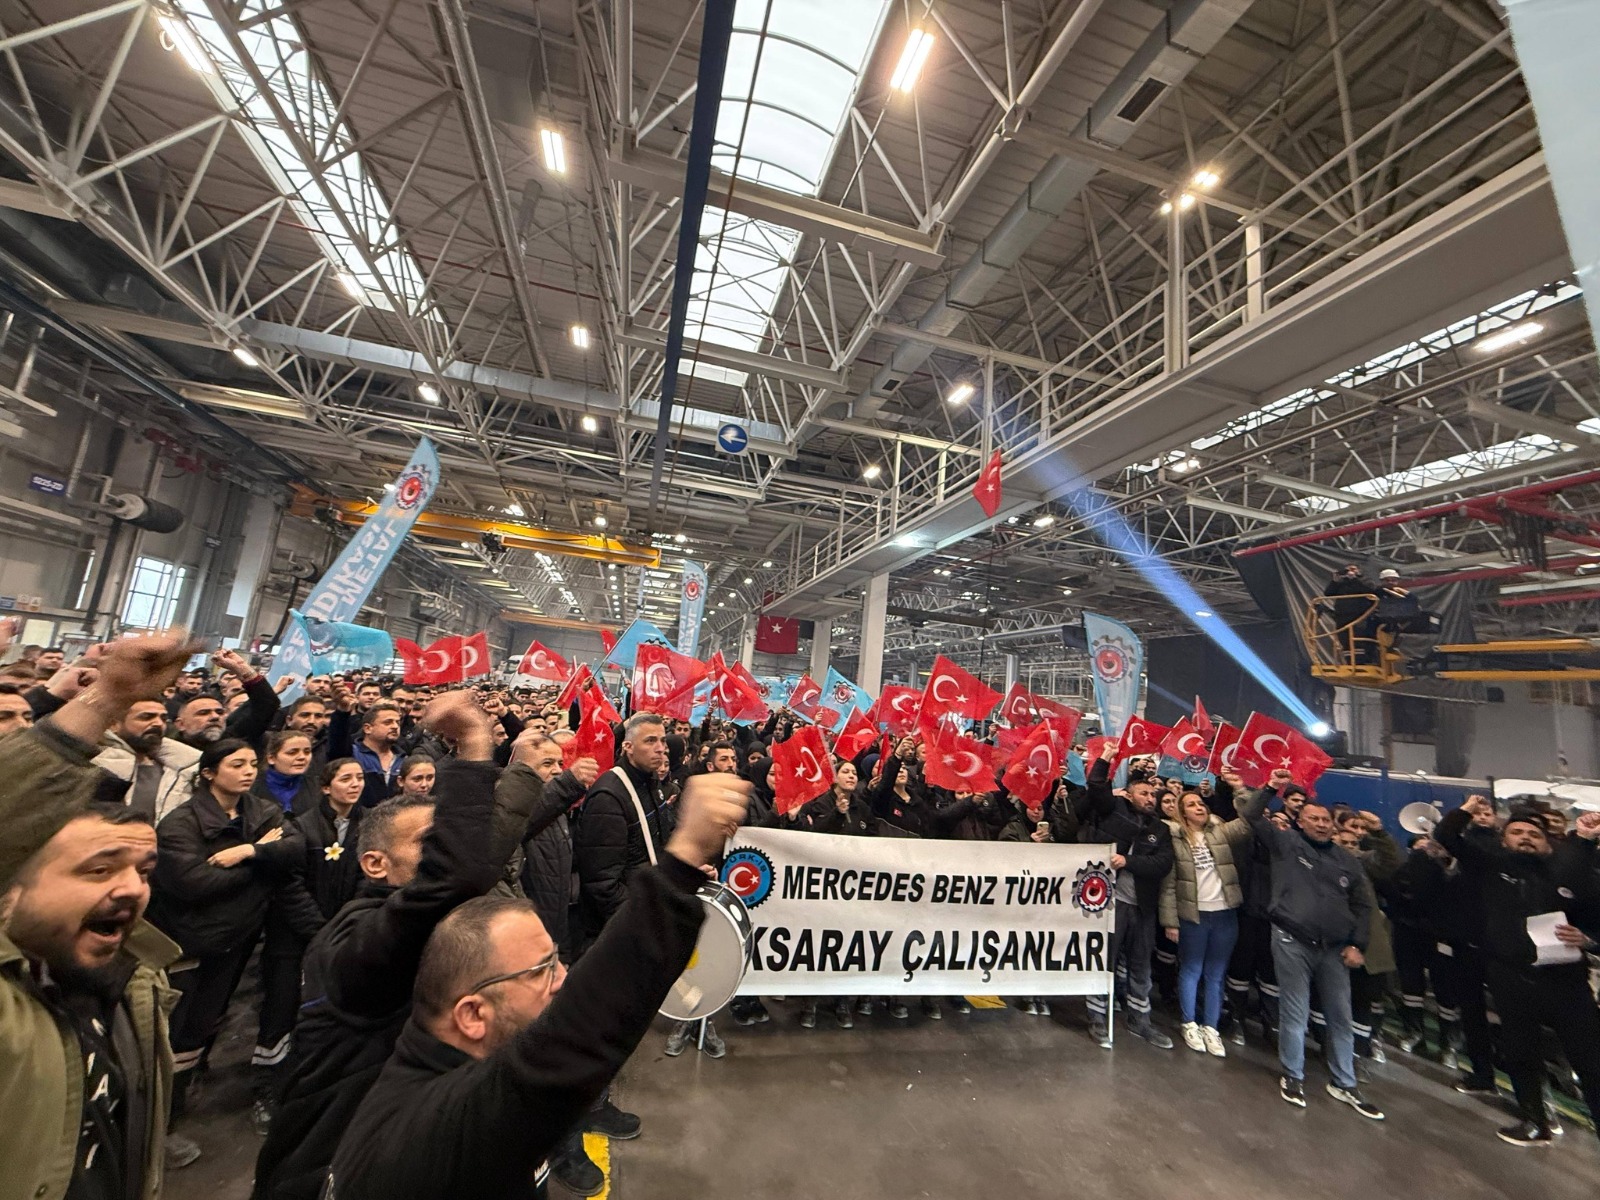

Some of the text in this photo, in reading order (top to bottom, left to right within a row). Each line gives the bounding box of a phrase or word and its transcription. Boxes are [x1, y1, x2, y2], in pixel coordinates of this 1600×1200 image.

[782, 865, 926, 903] MERCEDES
[930, 874, 998, 905] BENZ
[1004, 869, 1066, 905] TÜRK
[750, 926, 894, 972] KSARAY
